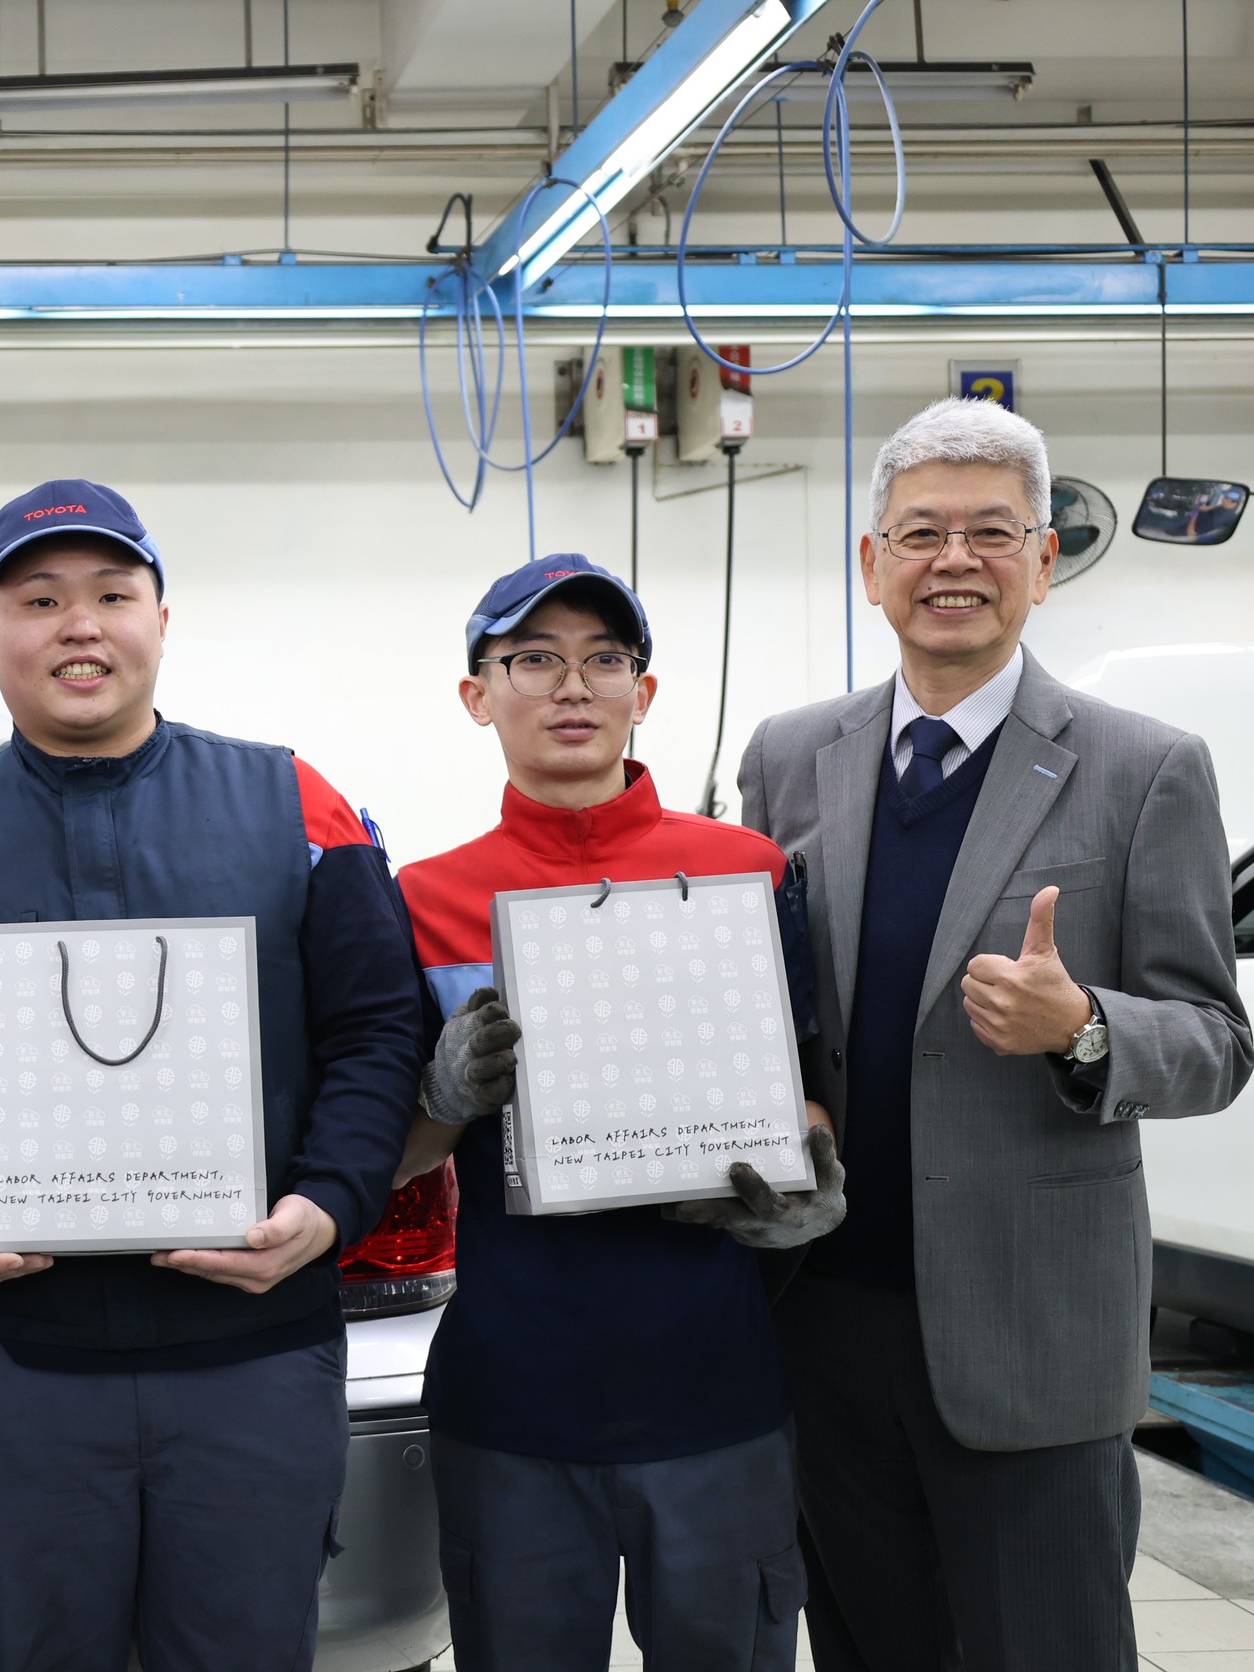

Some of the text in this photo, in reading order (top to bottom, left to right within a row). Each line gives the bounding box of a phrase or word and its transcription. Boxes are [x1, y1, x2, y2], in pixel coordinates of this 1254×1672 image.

[732, 419, 743, 432] 2
[23, 504, 88, 522] TOYOTA
[552, 1118, 772, 1147] LABOR AFFAIRS DEPARTMENT,
[554, 1135, 790, 1166] NEW TAIPEI CITY GOVERNMENT
[51, 1171, 116, 1185] AFFAIRS
[126, 1169, 225, 1182] DEPARTMENT,
[37, 1192, 92, 1205] TAIPEI
[100, 1190, 138, 1203] CITY
[147, 1189, 243, 1204] GOVERNMENT
